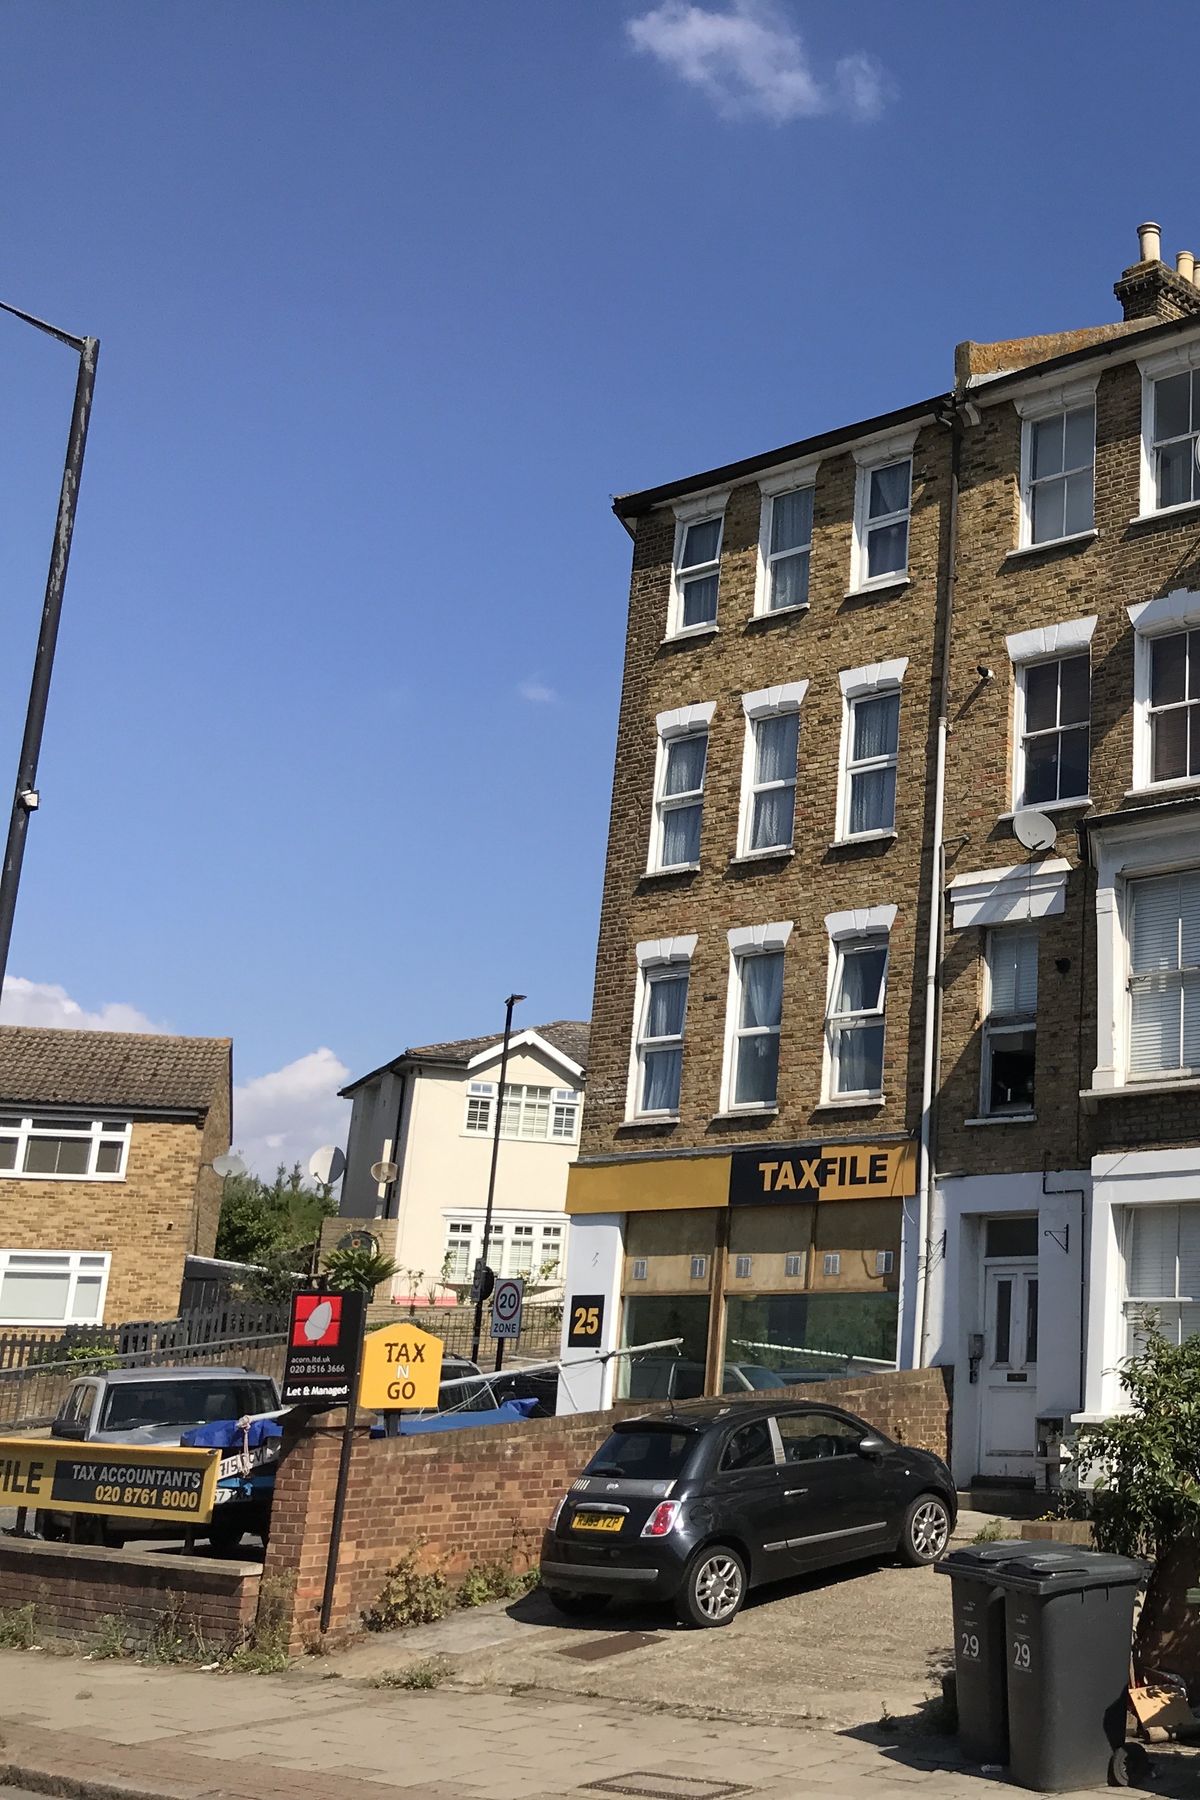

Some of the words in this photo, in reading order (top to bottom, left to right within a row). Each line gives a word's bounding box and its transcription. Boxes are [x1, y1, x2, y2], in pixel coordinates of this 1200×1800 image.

[758, 1153, 888, 1191] TAXFILE
[499, 1293, 517, 1309] 20
[493, 1323, 517, 1334] ZONE
[573, 1307, 599, 1335] 25
[291, 1355, 331, 1364] acorn.ltd.uk
[384, 1342, 426, 1363] TAX
[289, 1365, 305, 1374] 020
[306, 1365, 326, 1374] 8516
[327, 1364, 346, 1373] 3666
[396, 1364, 410, 1379] N
[286, 1386, 302, 1397] Let
[303, 1385, 311, 1396] &
[387, 1381, 416, 1400] GO
[72, 1464, 96, 1481] TAX
[99, 1466, 201, 1489] ACCOUNTANTS
[95, 1485, 120, 1503] 020
[123, 1487, 158, 1506] 8761
[161, 1490, 198, 1509] 8000
[961, 1632, 980, 1658] 29
[1013, 1641, 1031, 1668] 29
